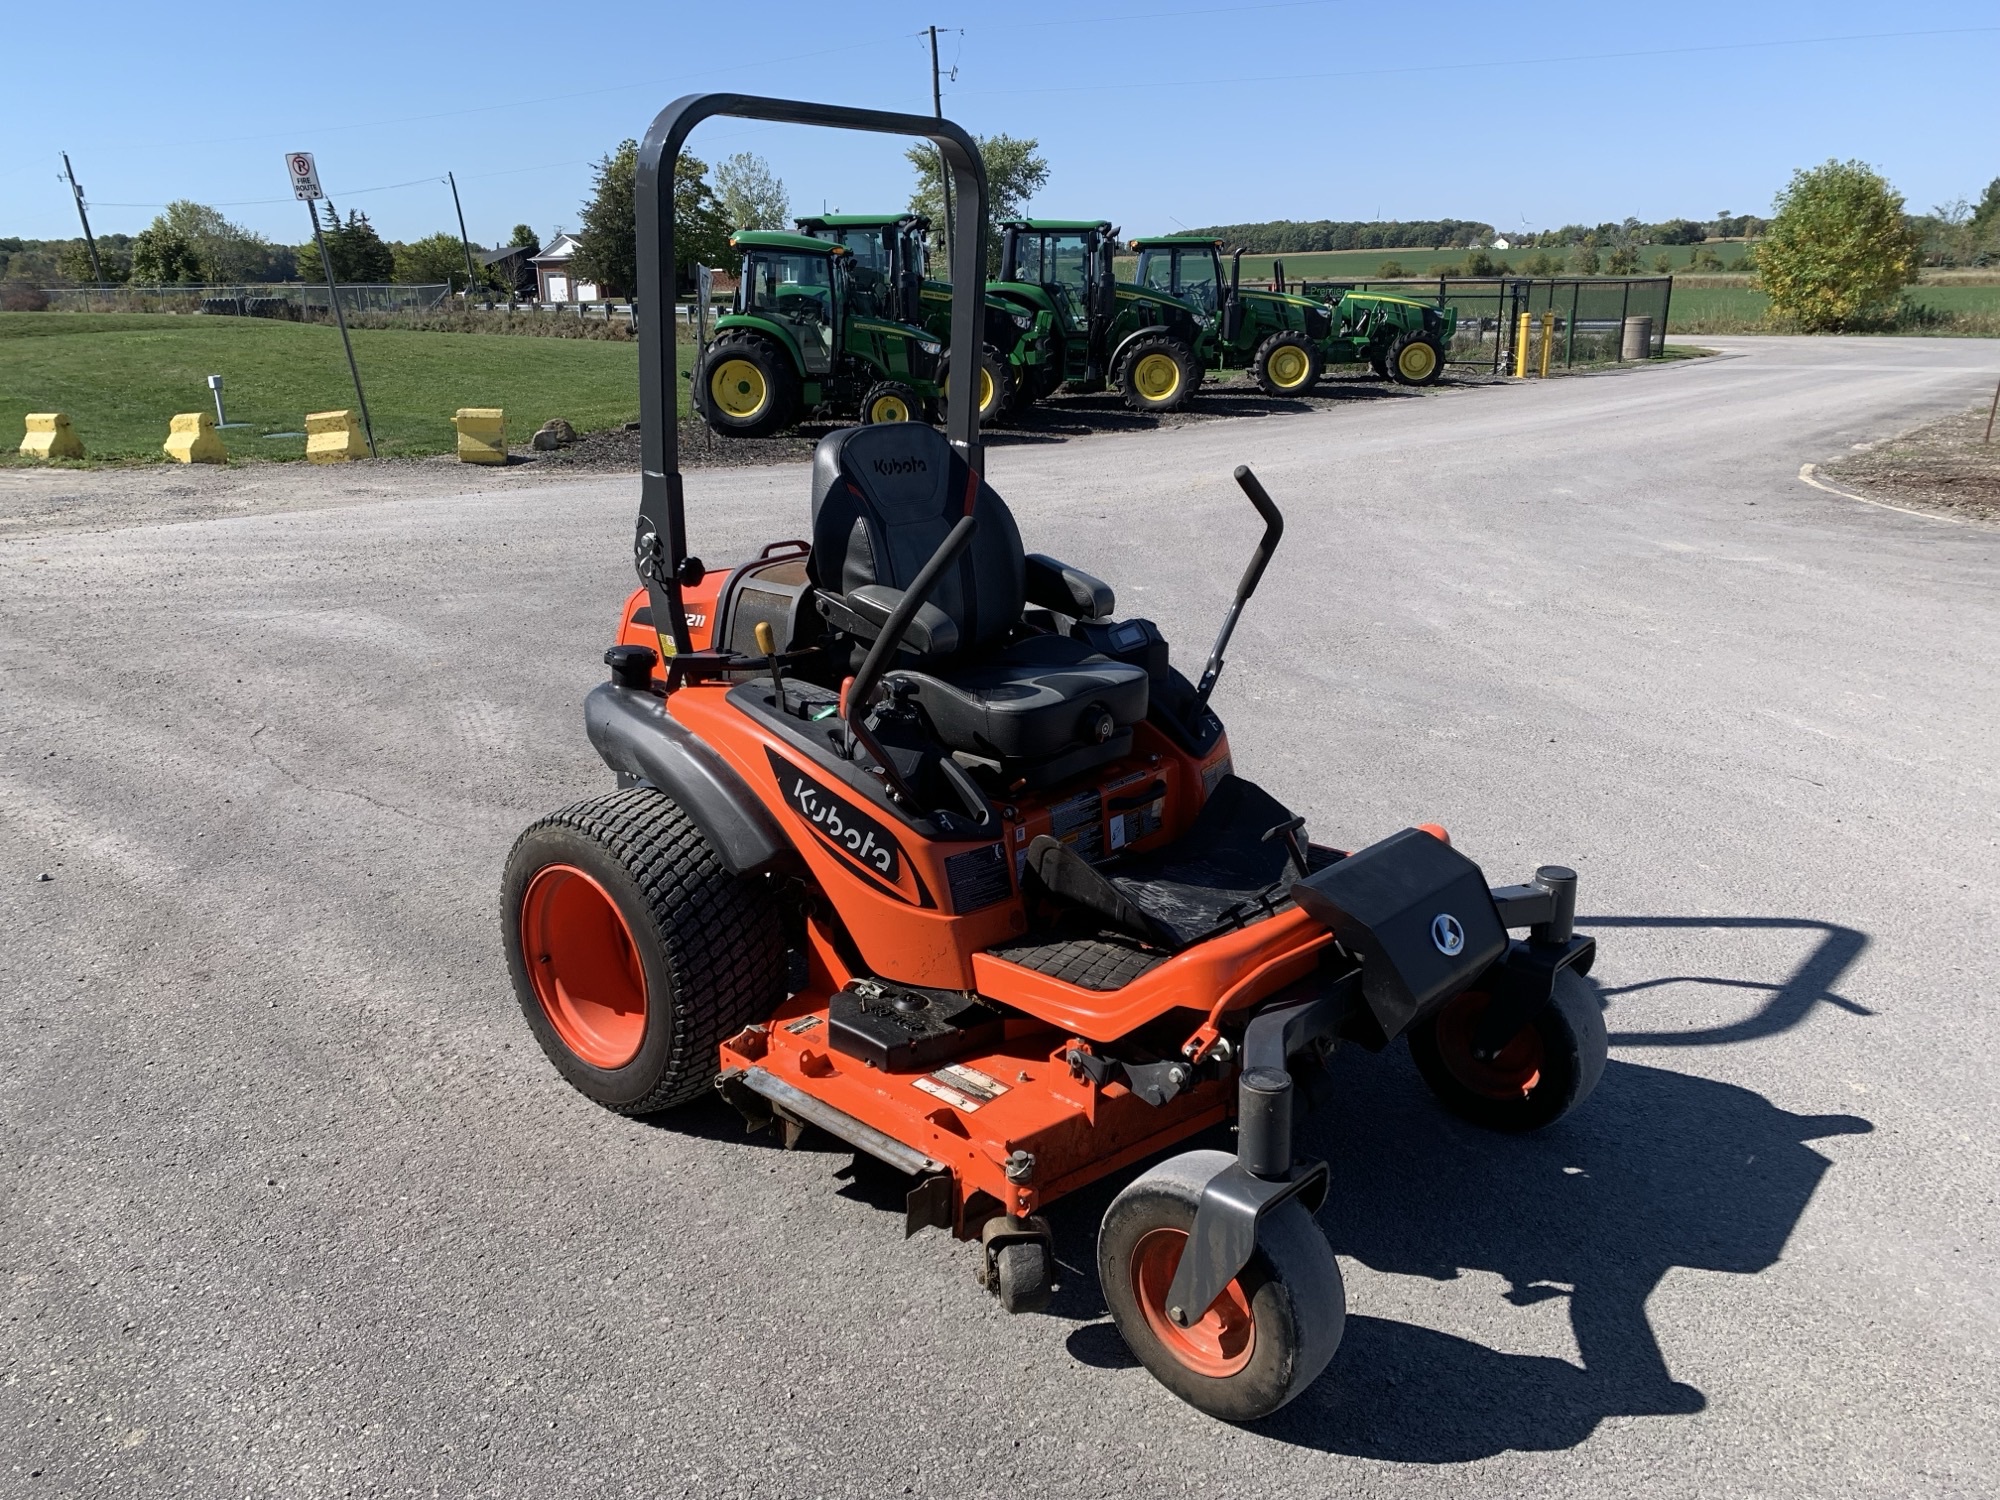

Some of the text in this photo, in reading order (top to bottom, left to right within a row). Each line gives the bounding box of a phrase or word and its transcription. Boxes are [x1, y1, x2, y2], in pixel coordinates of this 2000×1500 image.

[1310, 286, 1345, 296] Premier
[873, 456, 927, 476] Kubota
[684, 613, 707, 627] 211
[793, 778, 891, 873] Kubota
[888, 1013, 923, 1032] STEP
